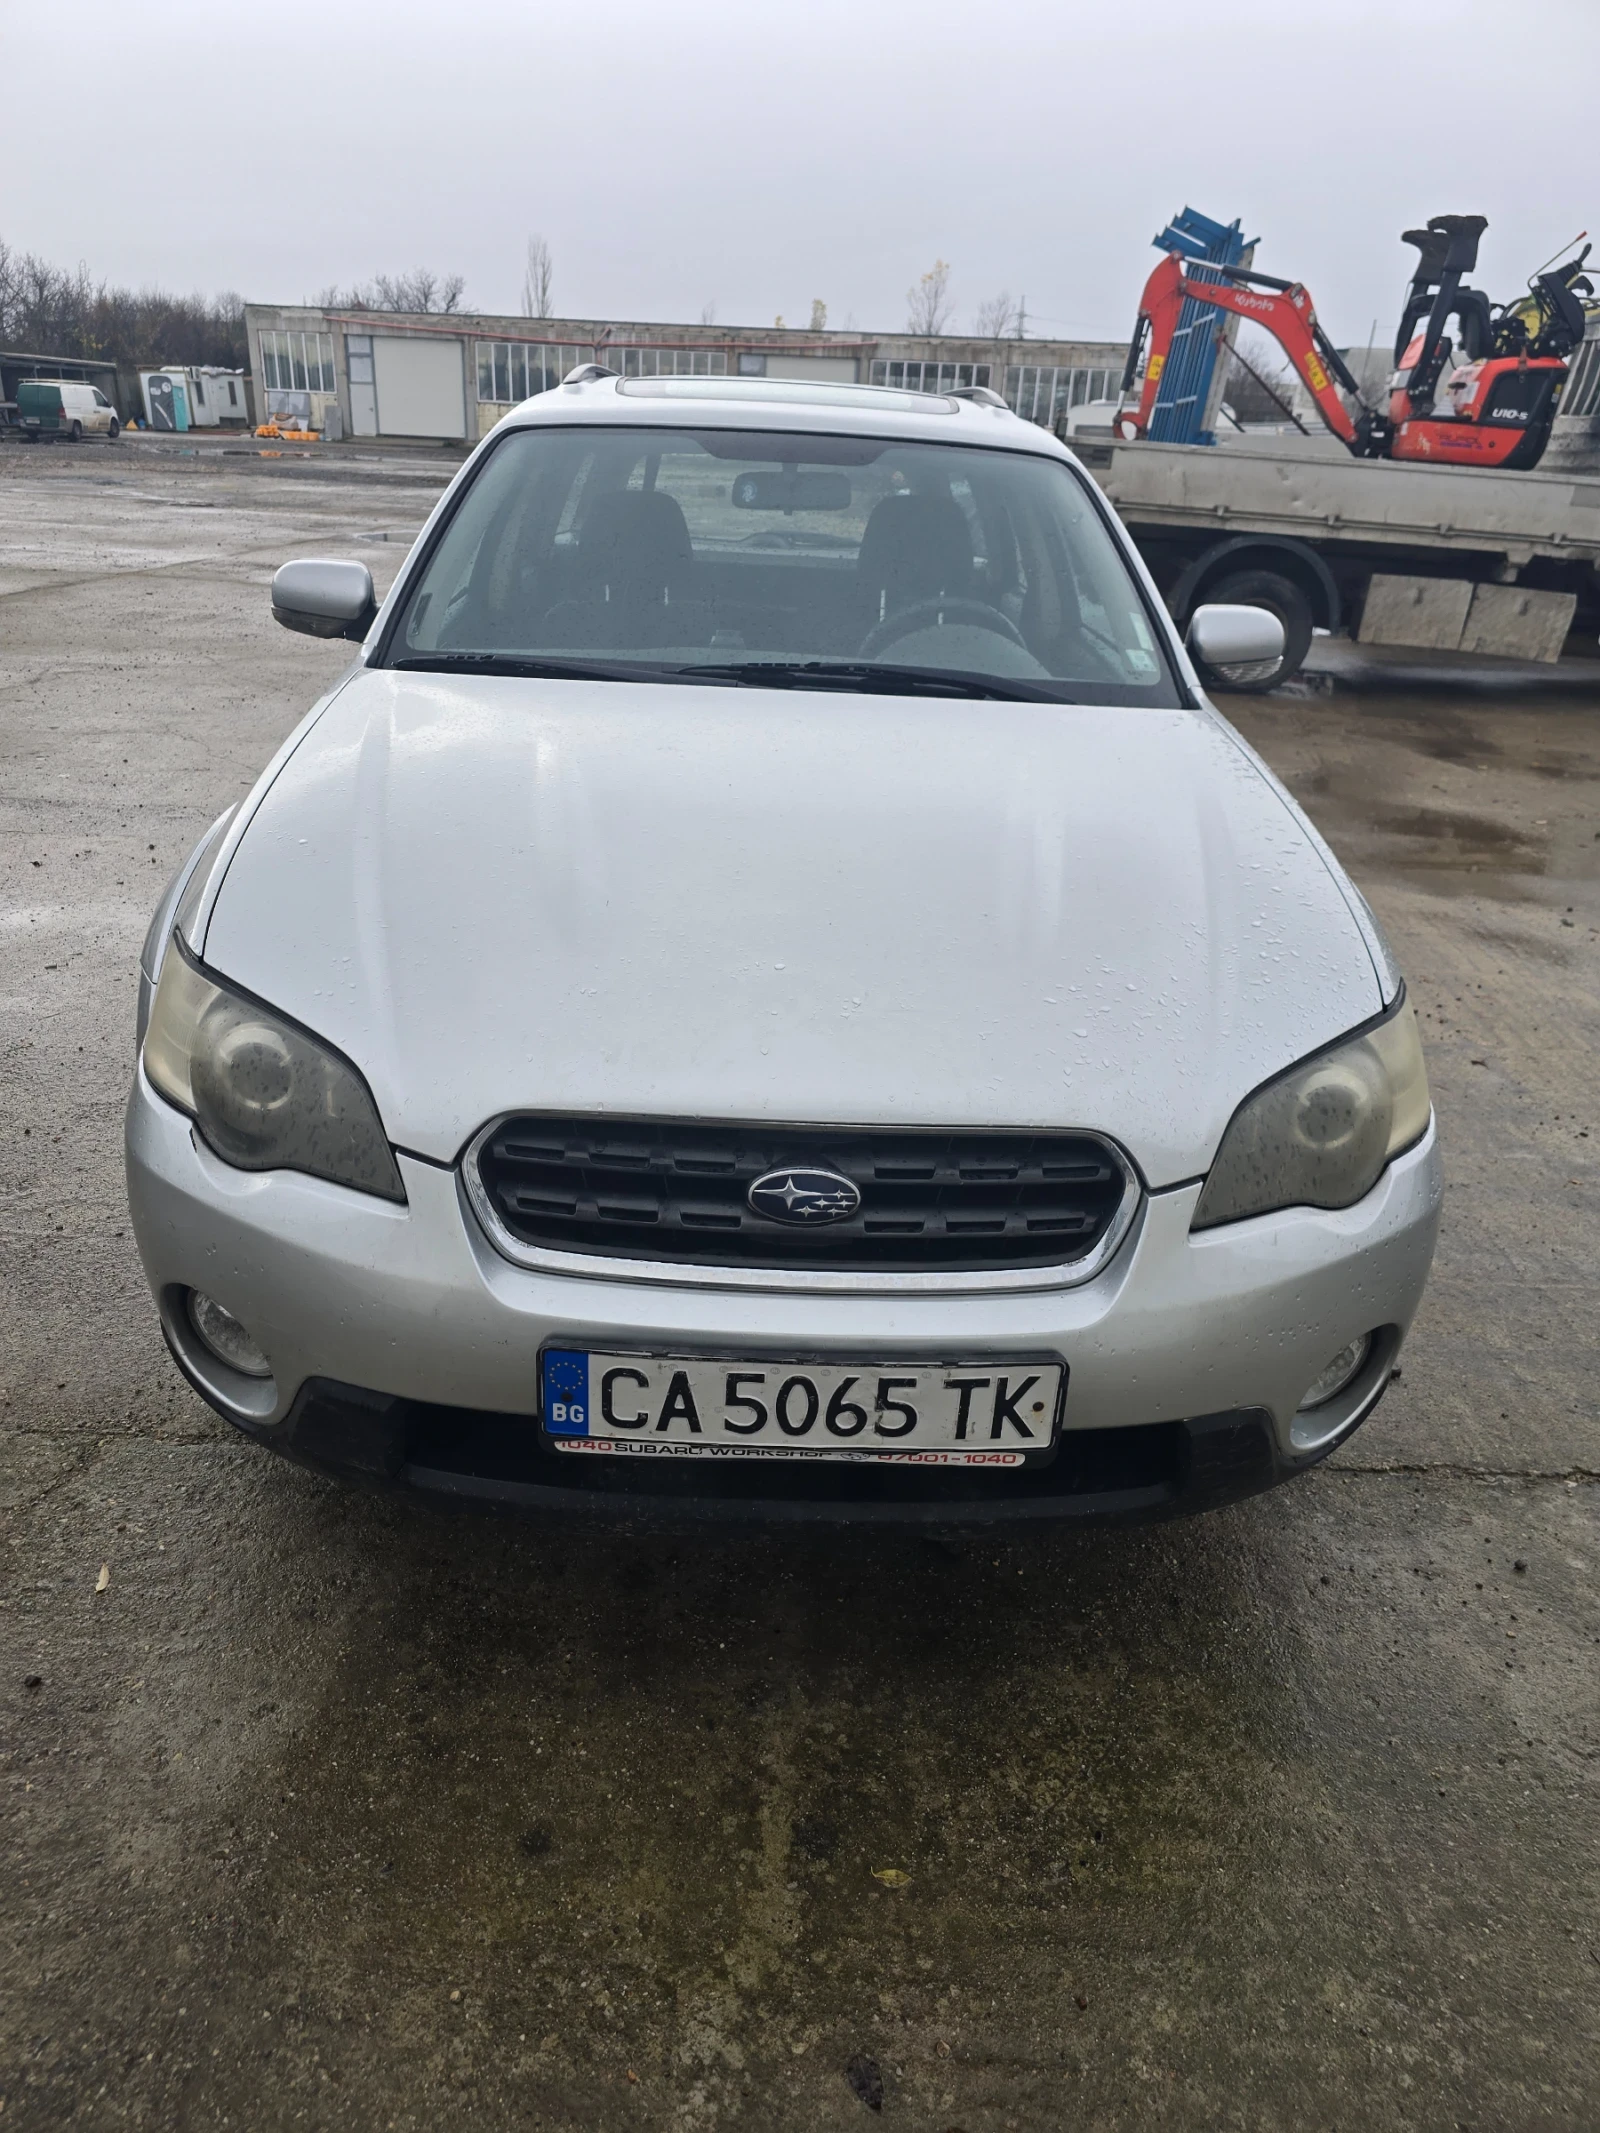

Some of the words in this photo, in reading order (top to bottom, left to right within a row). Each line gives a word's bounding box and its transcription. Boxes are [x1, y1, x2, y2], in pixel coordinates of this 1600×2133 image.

[552, 1403, 584, 1423] BG
[602, 1367, 702, 1433] CA
[724, 1372, 918, 1438] 5065
[943, 1375, 1042, 1440] TK
[614, 1442, 703, 1455] SUBARU
